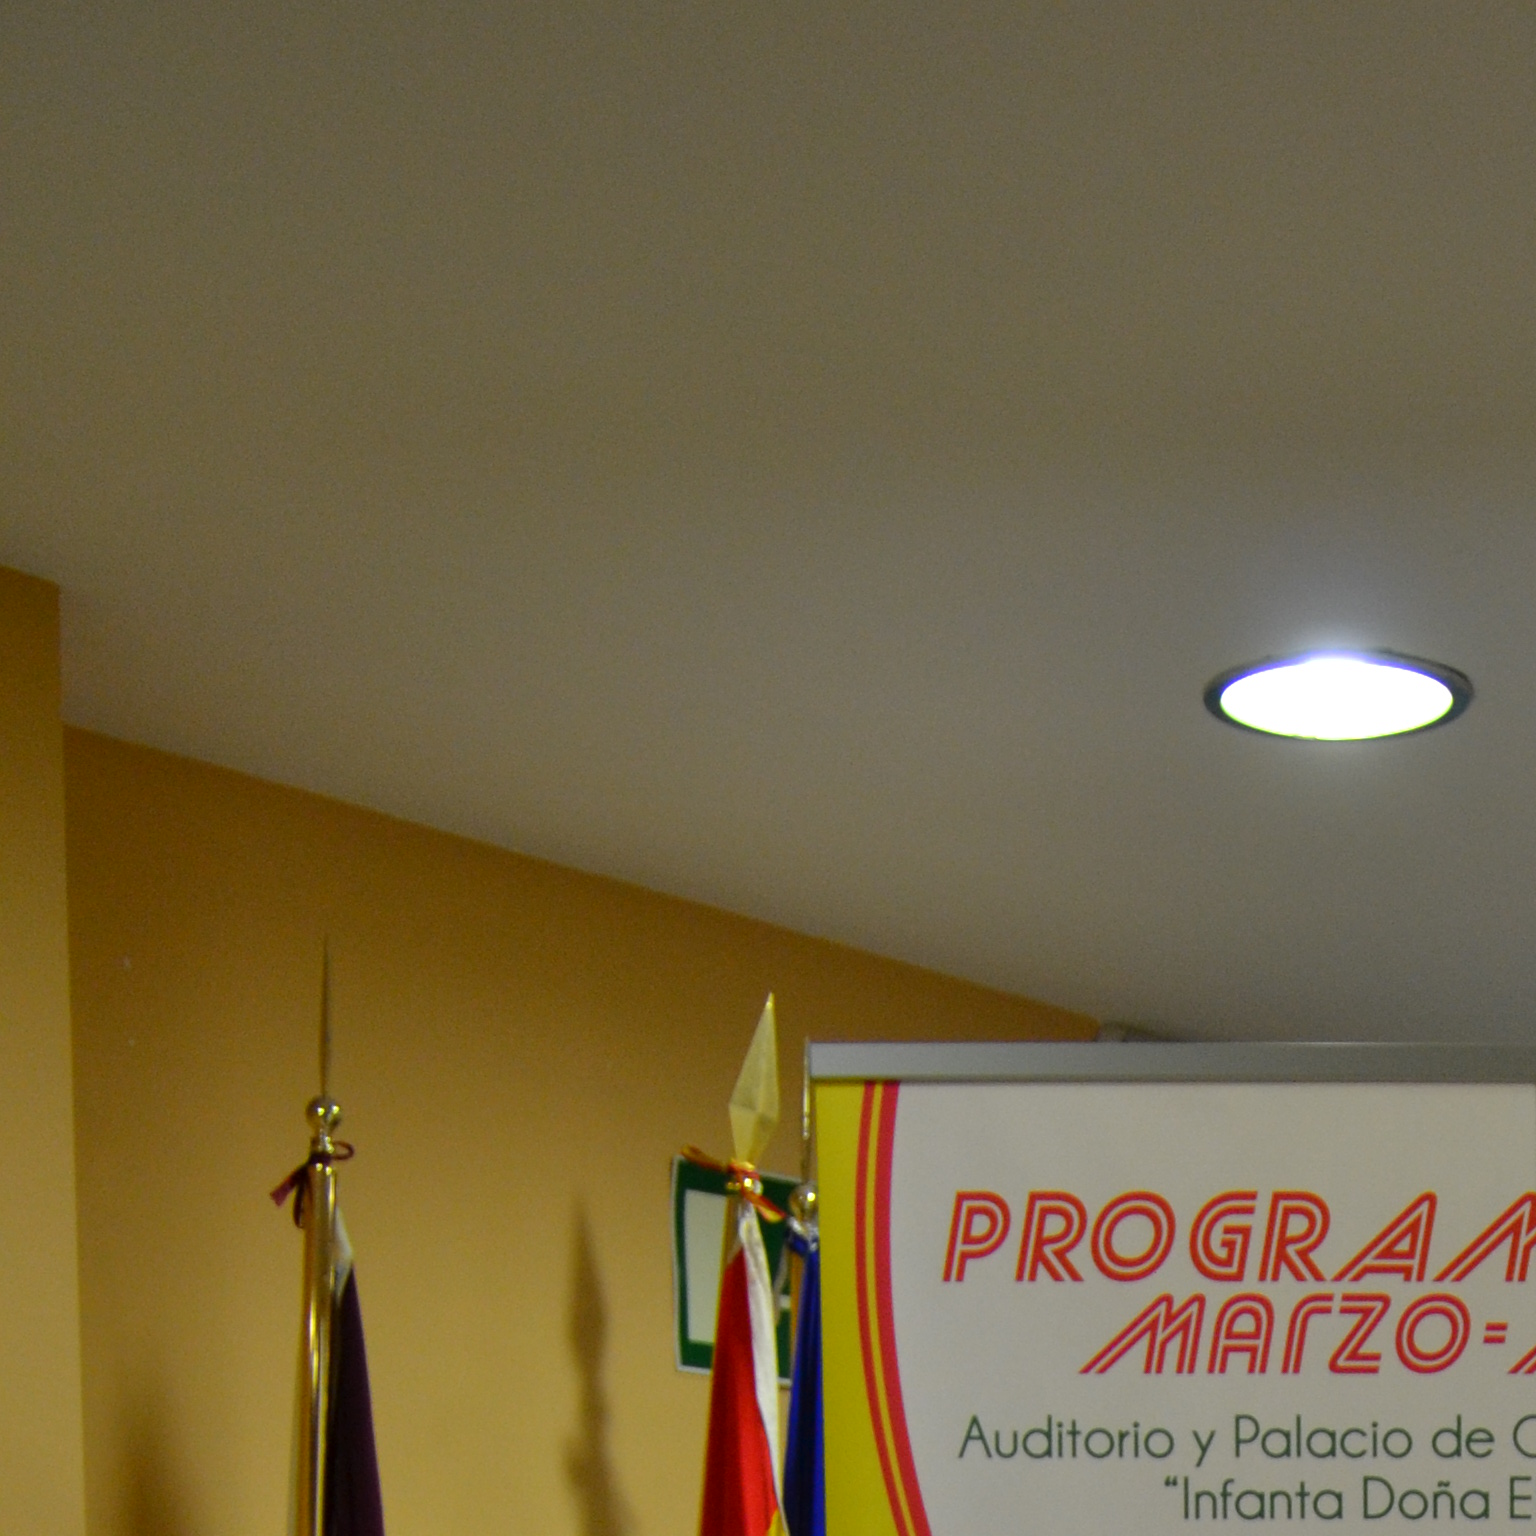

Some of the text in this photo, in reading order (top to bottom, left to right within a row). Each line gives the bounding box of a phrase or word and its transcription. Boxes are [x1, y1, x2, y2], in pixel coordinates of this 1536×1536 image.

[959, 1415, 1174, 1458] Auditorio
[1193, 1431, 1215, 1467] y
[1235, 1414, 1412, 1458] Palacio
[1432, 1414, 1494, 1458] de
[1363, 1476, 1489, 1520] Doña
